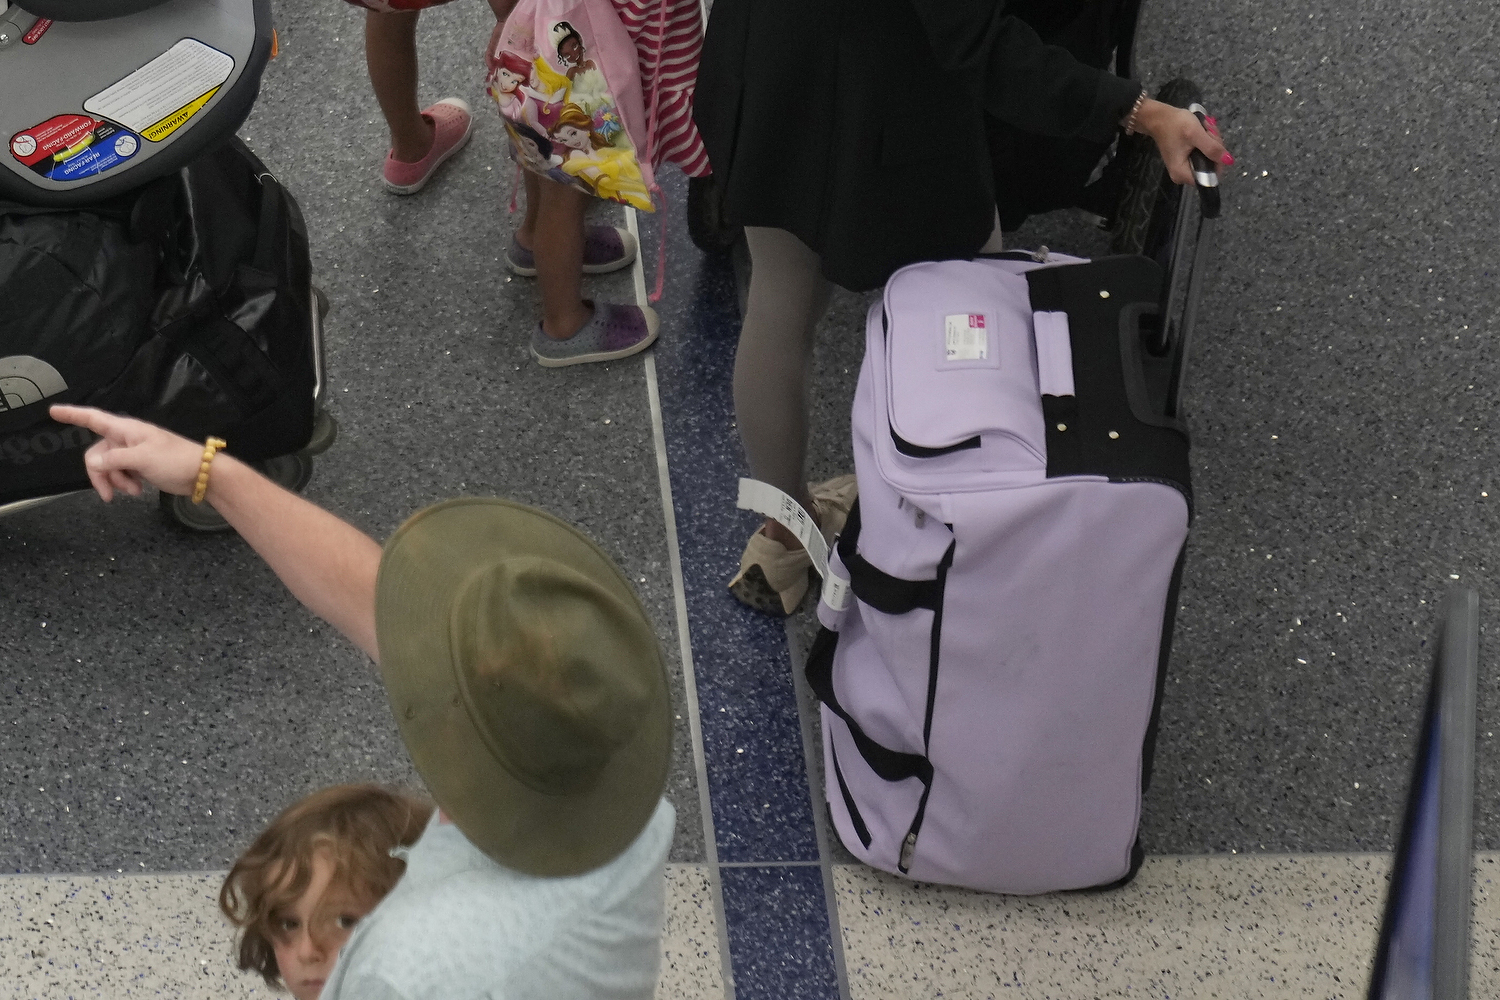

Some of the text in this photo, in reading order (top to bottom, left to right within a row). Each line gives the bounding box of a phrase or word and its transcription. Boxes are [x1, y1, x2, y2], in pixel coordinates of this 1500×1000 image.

[42, 120, 92, 152] FORWARD-FACING
[149, 116, 184, 140] WARNING!
[63, 151, 101, 176] REAR-FACING
